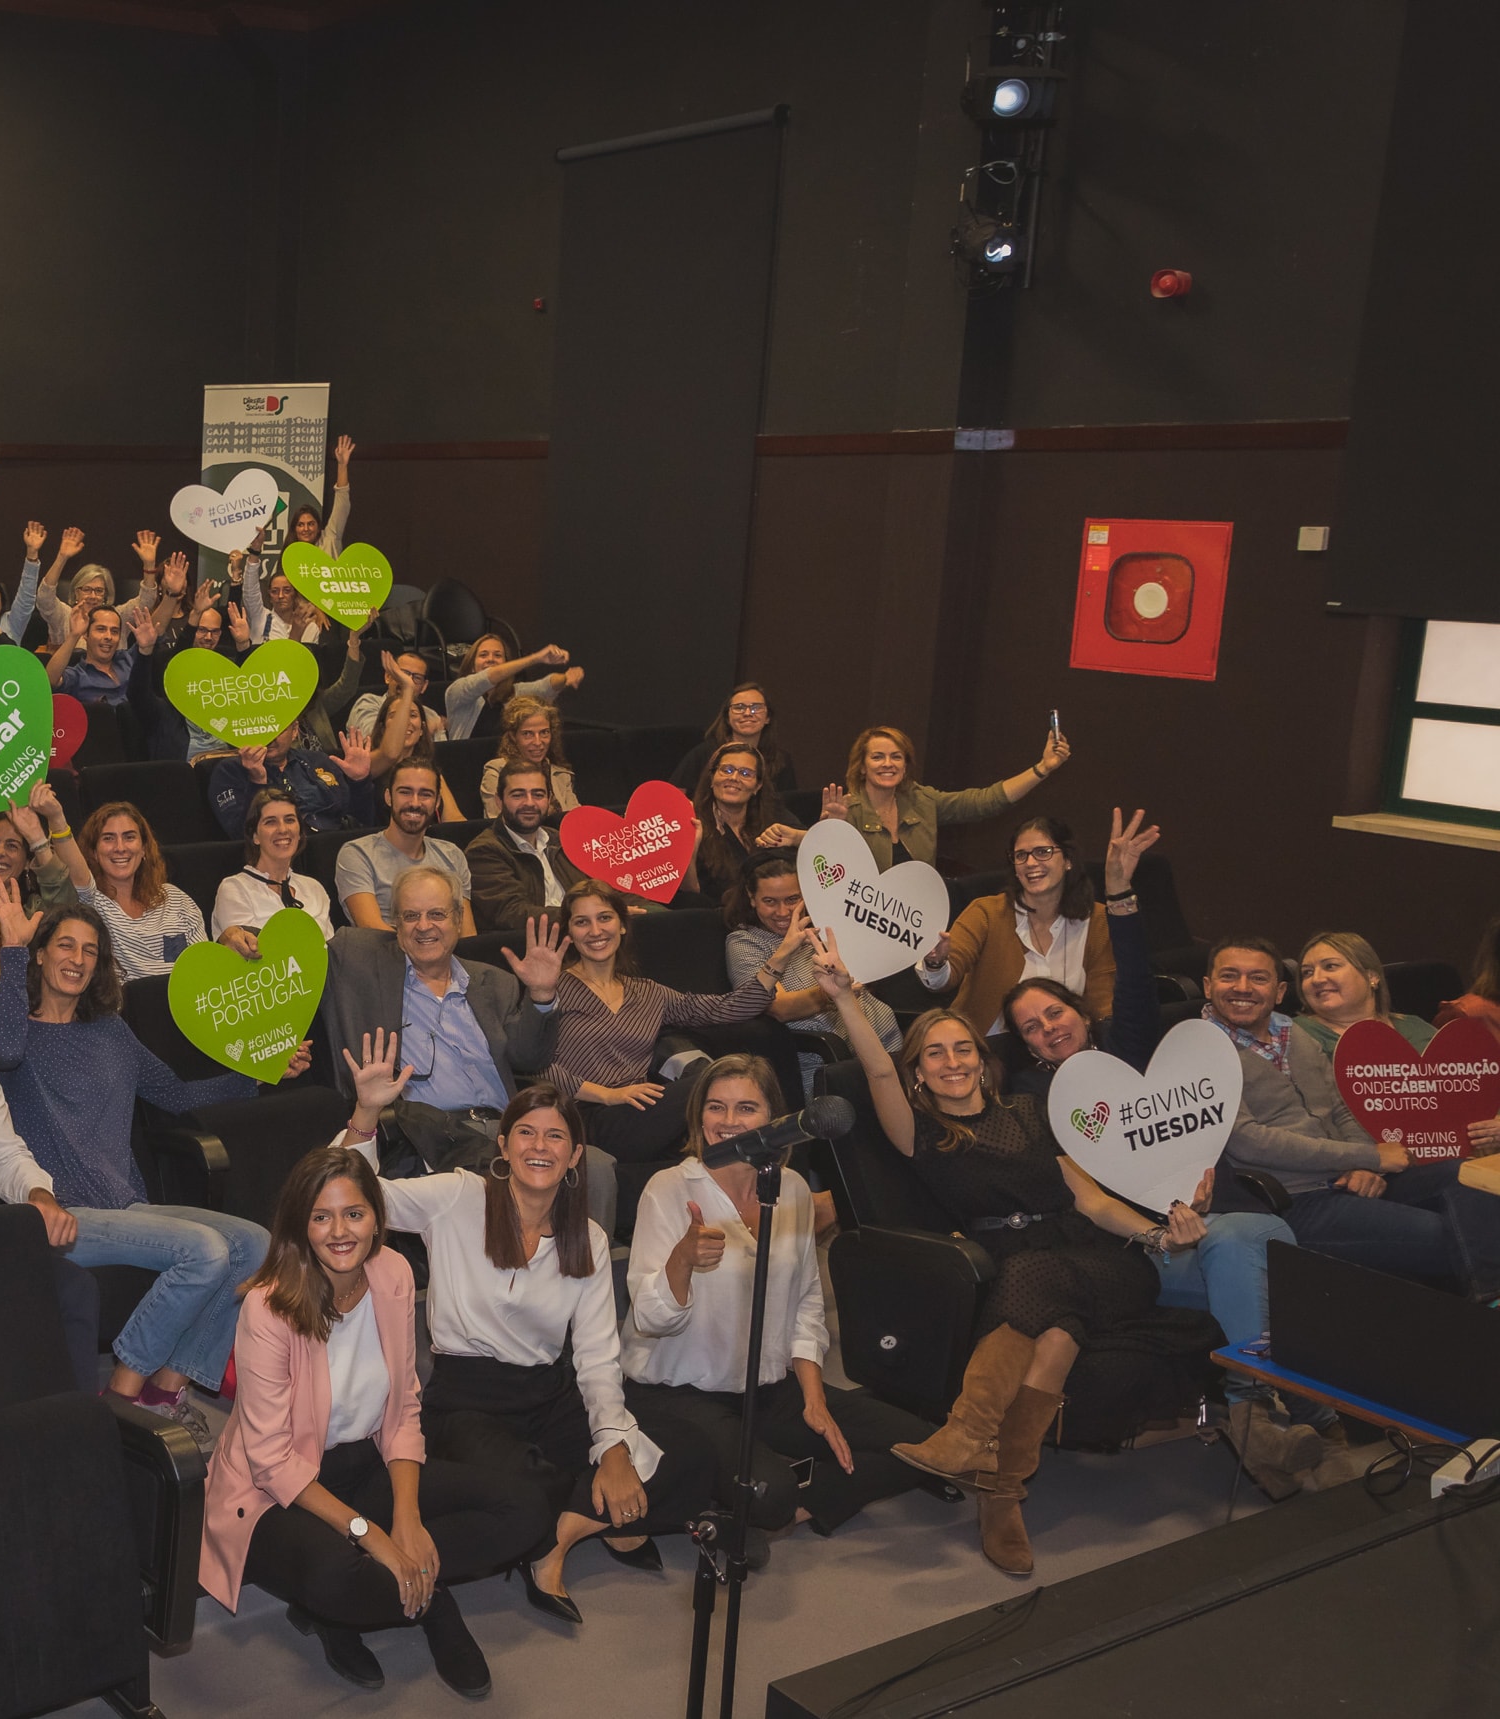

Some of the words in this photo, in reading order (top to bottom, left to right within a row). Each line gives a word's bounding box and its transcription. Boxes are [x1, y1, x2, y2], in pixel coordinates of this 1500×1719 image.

[206, 428, 230, 436] CASA
[234, 428, 248, 436] DOS
[252, 427, 287, 435] DIREITOS
[291, 426, 324, 434] SOCIAIS
[206, 438, 229, 446] CASA
[234, 438, 248, 446] DOS
[252, 437, 287, 445] DIREITOS
[290, 436, 324, 444] SOCIAIS
[208, 494, 262, 517] #GIVING
[211, 505, 267, 528] TUESDAY
[298, 564, 382, 578] #éaminha
[320, 580, 370, 593] causa
[338, 608, 371, 616] TUESDAY
[187, 671, 291, 696] #CHEGOUA
[202, 686, 299, 709] PORTUGAL
[232, 715, 276, 727] #GIVING
[233, 724, 280, 736] TUESDAY
[1, 751, 46, 799] TUESDAY
[582, 814, 666, 853] #ACAUSAQUE
[592, 820, 681, 862] ABRAÇATODAS
[609, 836, 672, 868] ASCAUSAS
[636, 862, 674, 882] #GIVING
[640, 870, 680, 891] TUESDAY
[848, 879, 923, 928] #GIVING
[844, 899, 924, 950] TUESDAY
[195, 956, 302, 1015] #CHEGOUA
[212, 976, 312, 1032] PORTUGAL
[248, 1023, 293, 1051] #GIVING
[250, 1034, 298, 1064] TUESDAY
[1346, 1059, 1500, 1080] #CONHEÇAUMCORAÇÃO
[1119, 1078, 1215, 1125] #GIVING
[1364, 1097, 1438, 1112] OSOUTROS
[1124, 1102, 1224, 1151] TUESDAY
[1407, 1131, 1457, 1144] #GIVING
